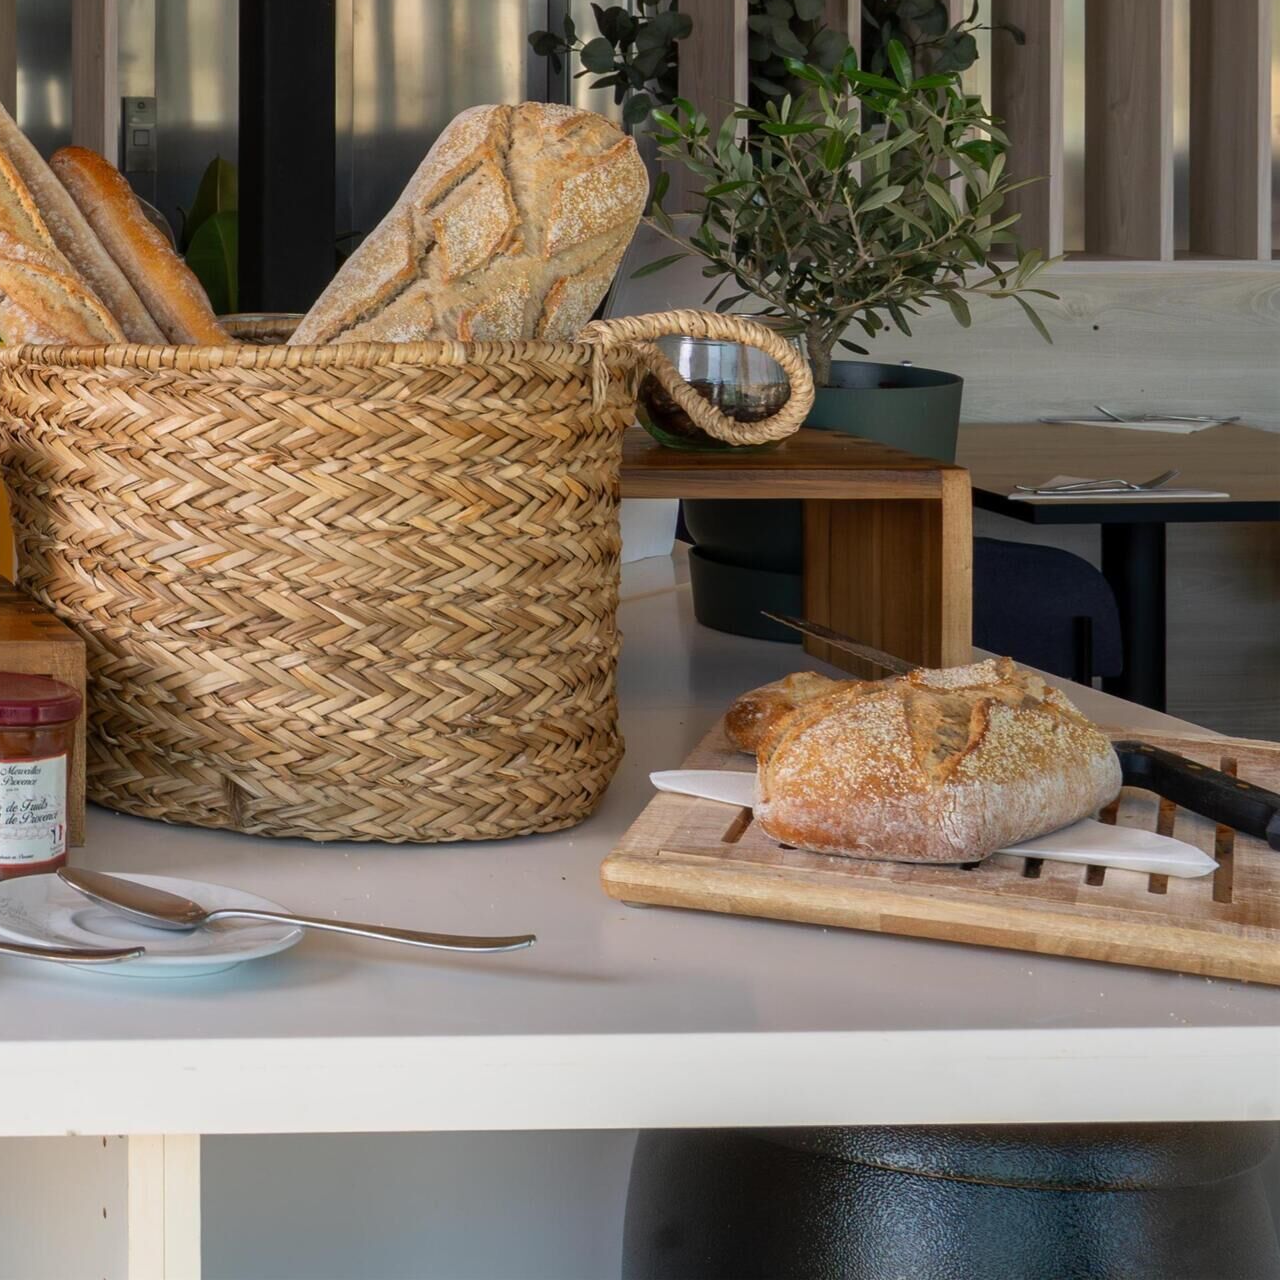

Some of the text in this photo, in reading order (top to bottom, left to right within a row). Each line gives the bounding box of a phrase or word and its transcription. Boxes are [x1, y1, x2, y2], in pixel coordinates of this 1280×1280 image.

[1, 776, 37, 787] Provence
[6, 801, 18, 813] de
[20, 798, 48, 813] Fruits
[5, 814, 18, 825] de
[19, 811, 58, 824] Provence
